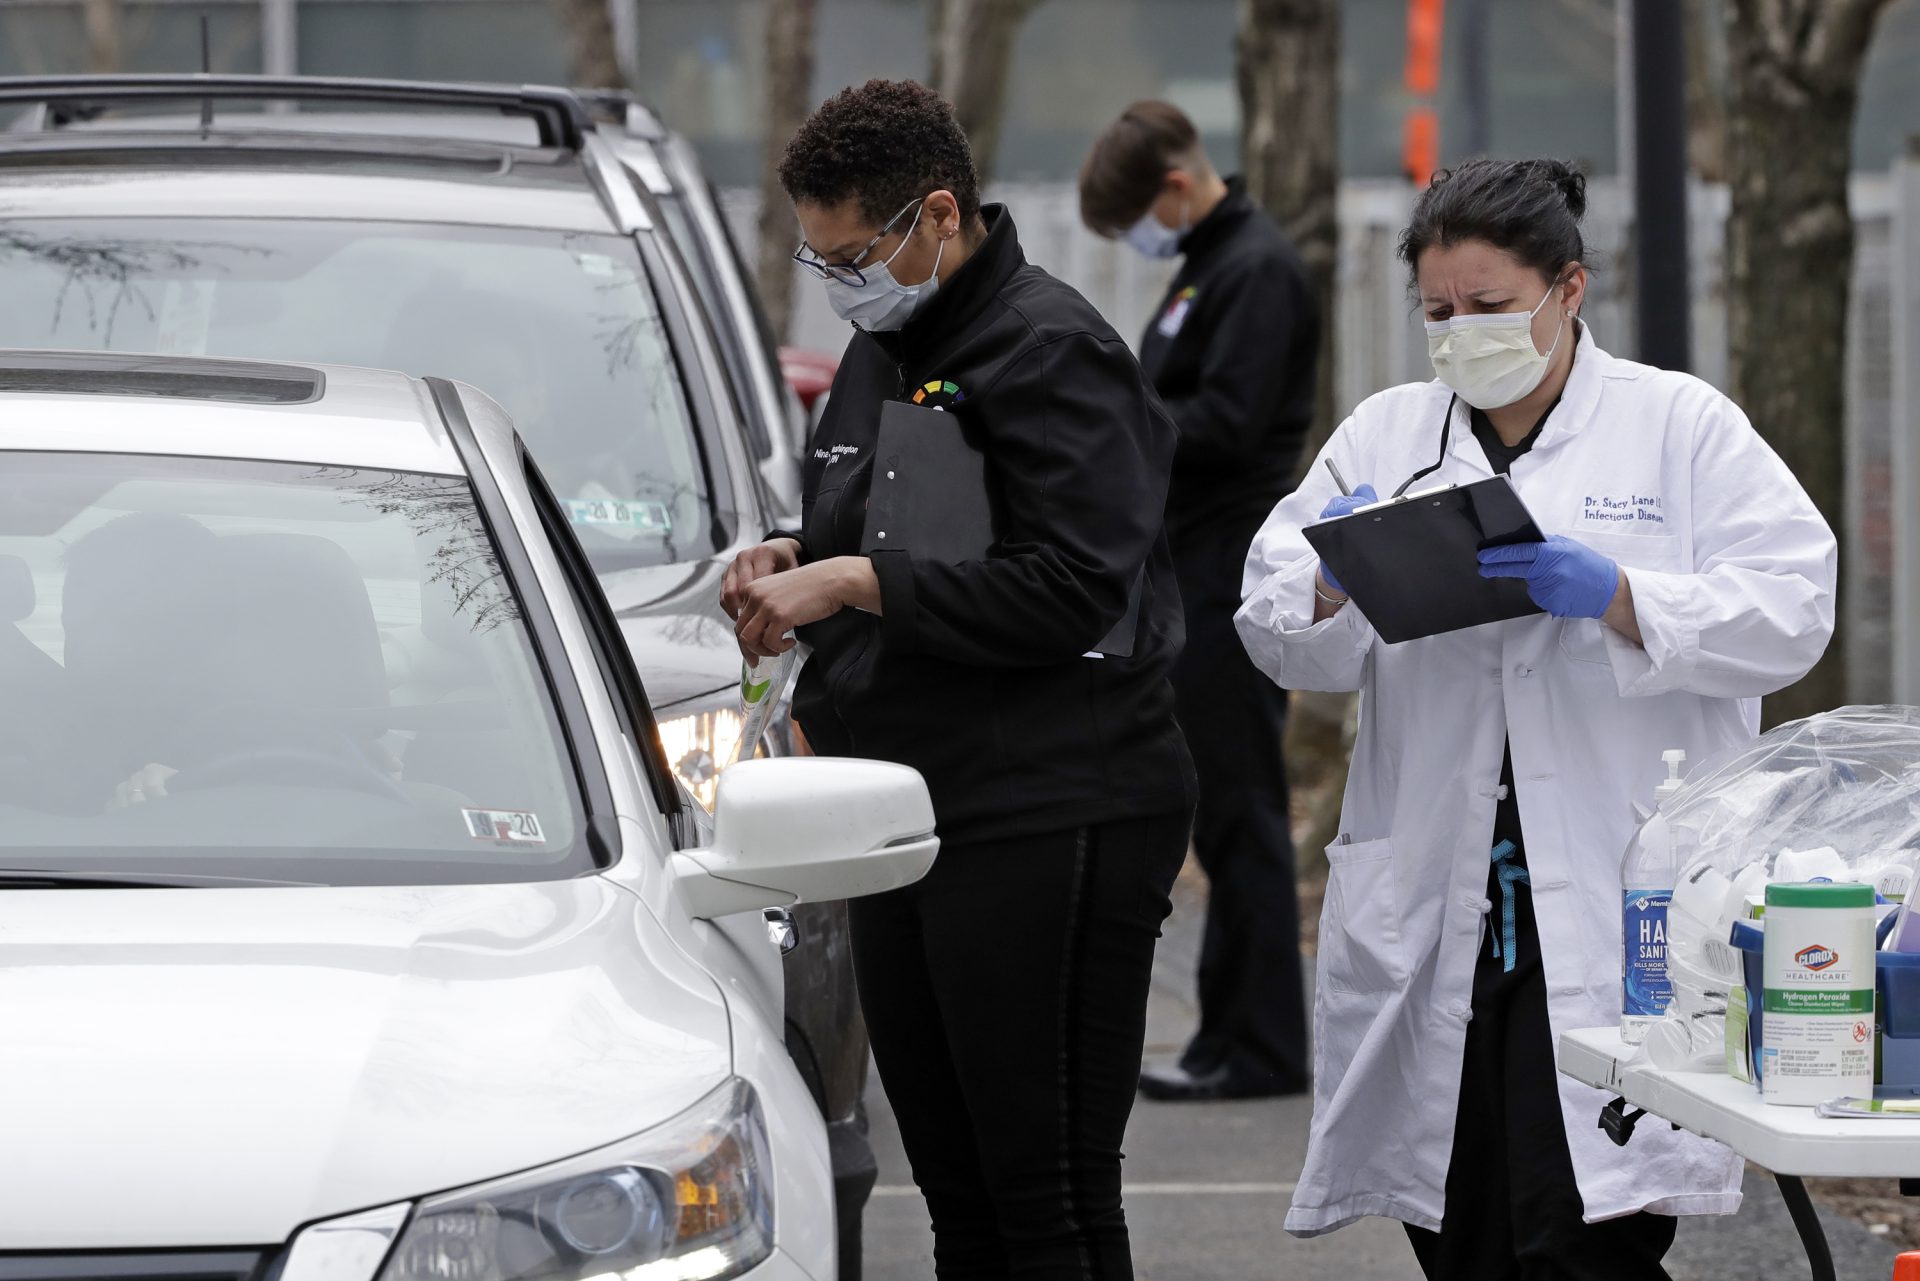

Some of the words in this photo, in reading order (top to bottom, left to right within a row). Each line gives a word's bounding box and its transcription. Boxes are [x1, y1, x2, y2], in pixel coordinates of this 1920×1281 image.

[1585, 497, 1599, 507] Dr.
[1602, 497, 1628, 510] Stacy
[1631, 495, 1654, 506] Lane
[1584, 509, 1634, 522] Infectious
[514, 813, 539, 837] 20
[1640, 919, 1665, 943] HA
[1798, 949, 1834, 966] CLOROX
[1783, 992, 1817, 1001] Hydrogen
[1819, 992, 1850, 1001] Peroxide
